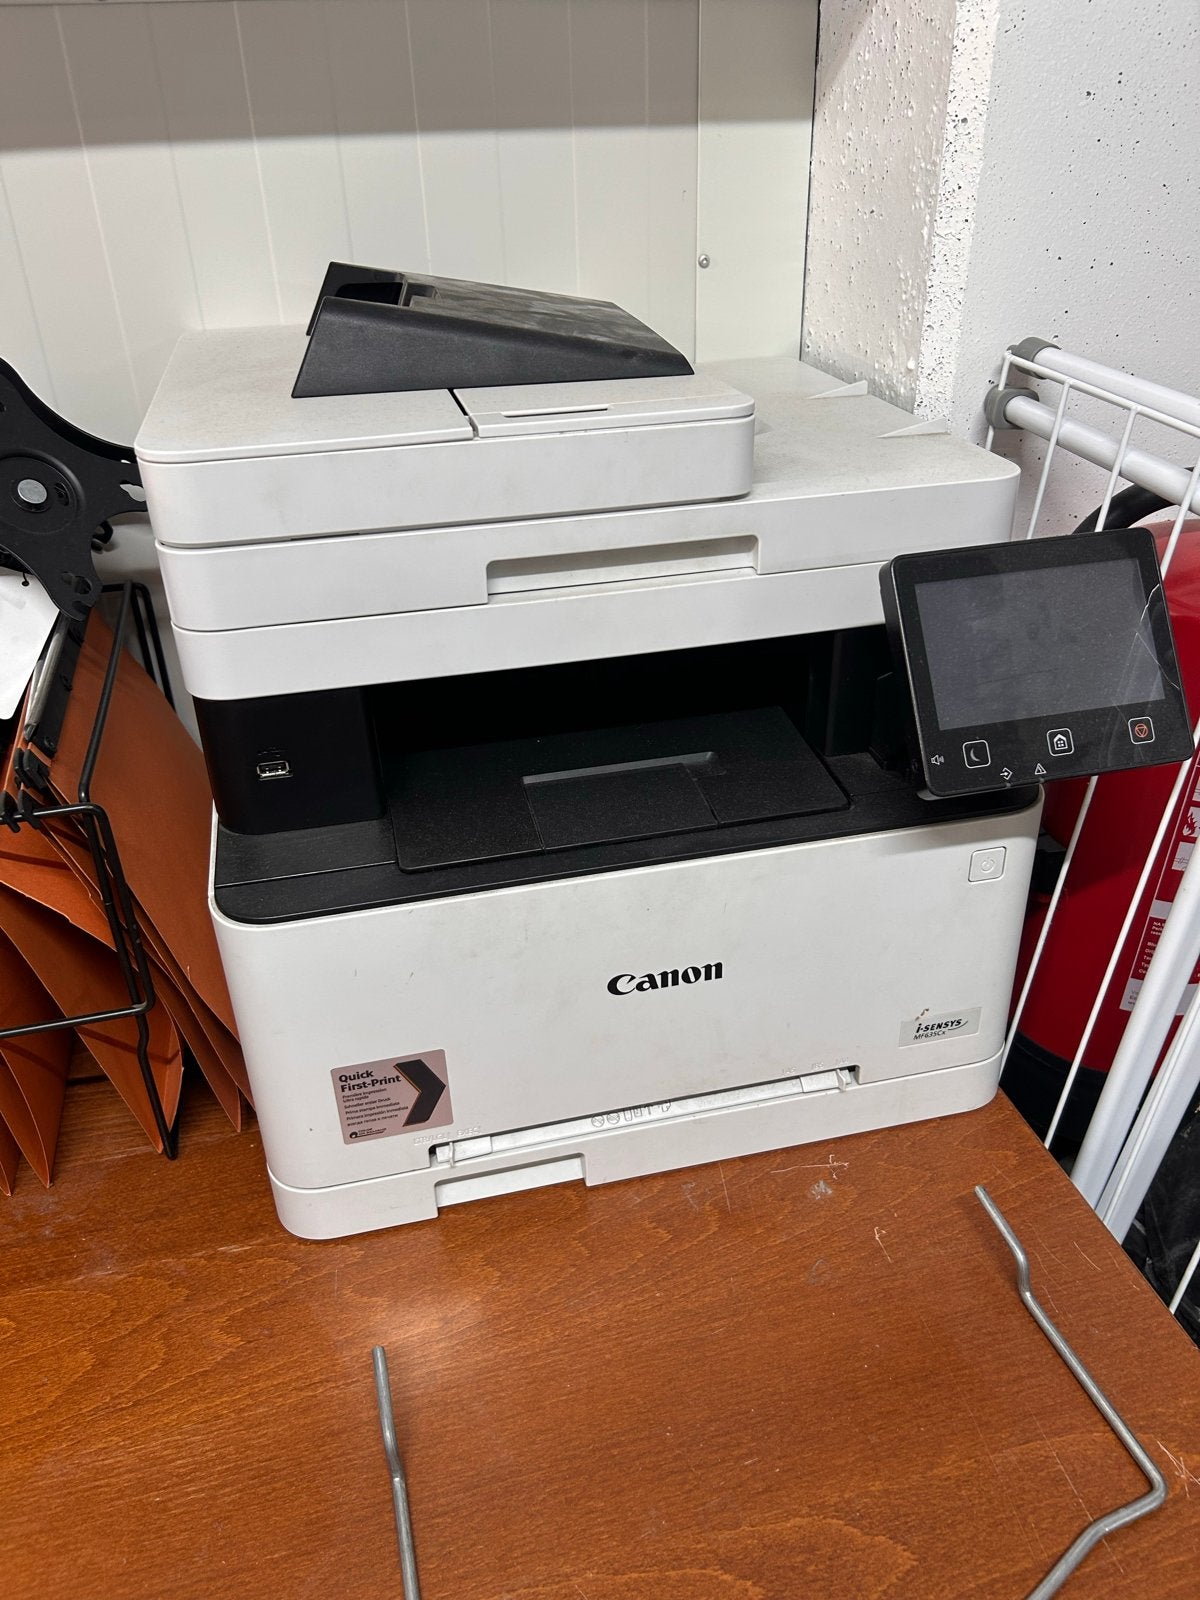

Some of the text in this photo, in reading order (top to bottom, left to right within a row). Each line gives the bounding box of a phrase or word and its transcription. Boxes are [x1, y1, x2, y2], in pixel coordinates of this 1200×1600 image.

[607, 961, 723, 996] Canon
[916, 1019, 962, 1033] i-SENSYS
[339, 1070, 374, 1083] Quick
[340, 1075, 401, 1092] First-Print
